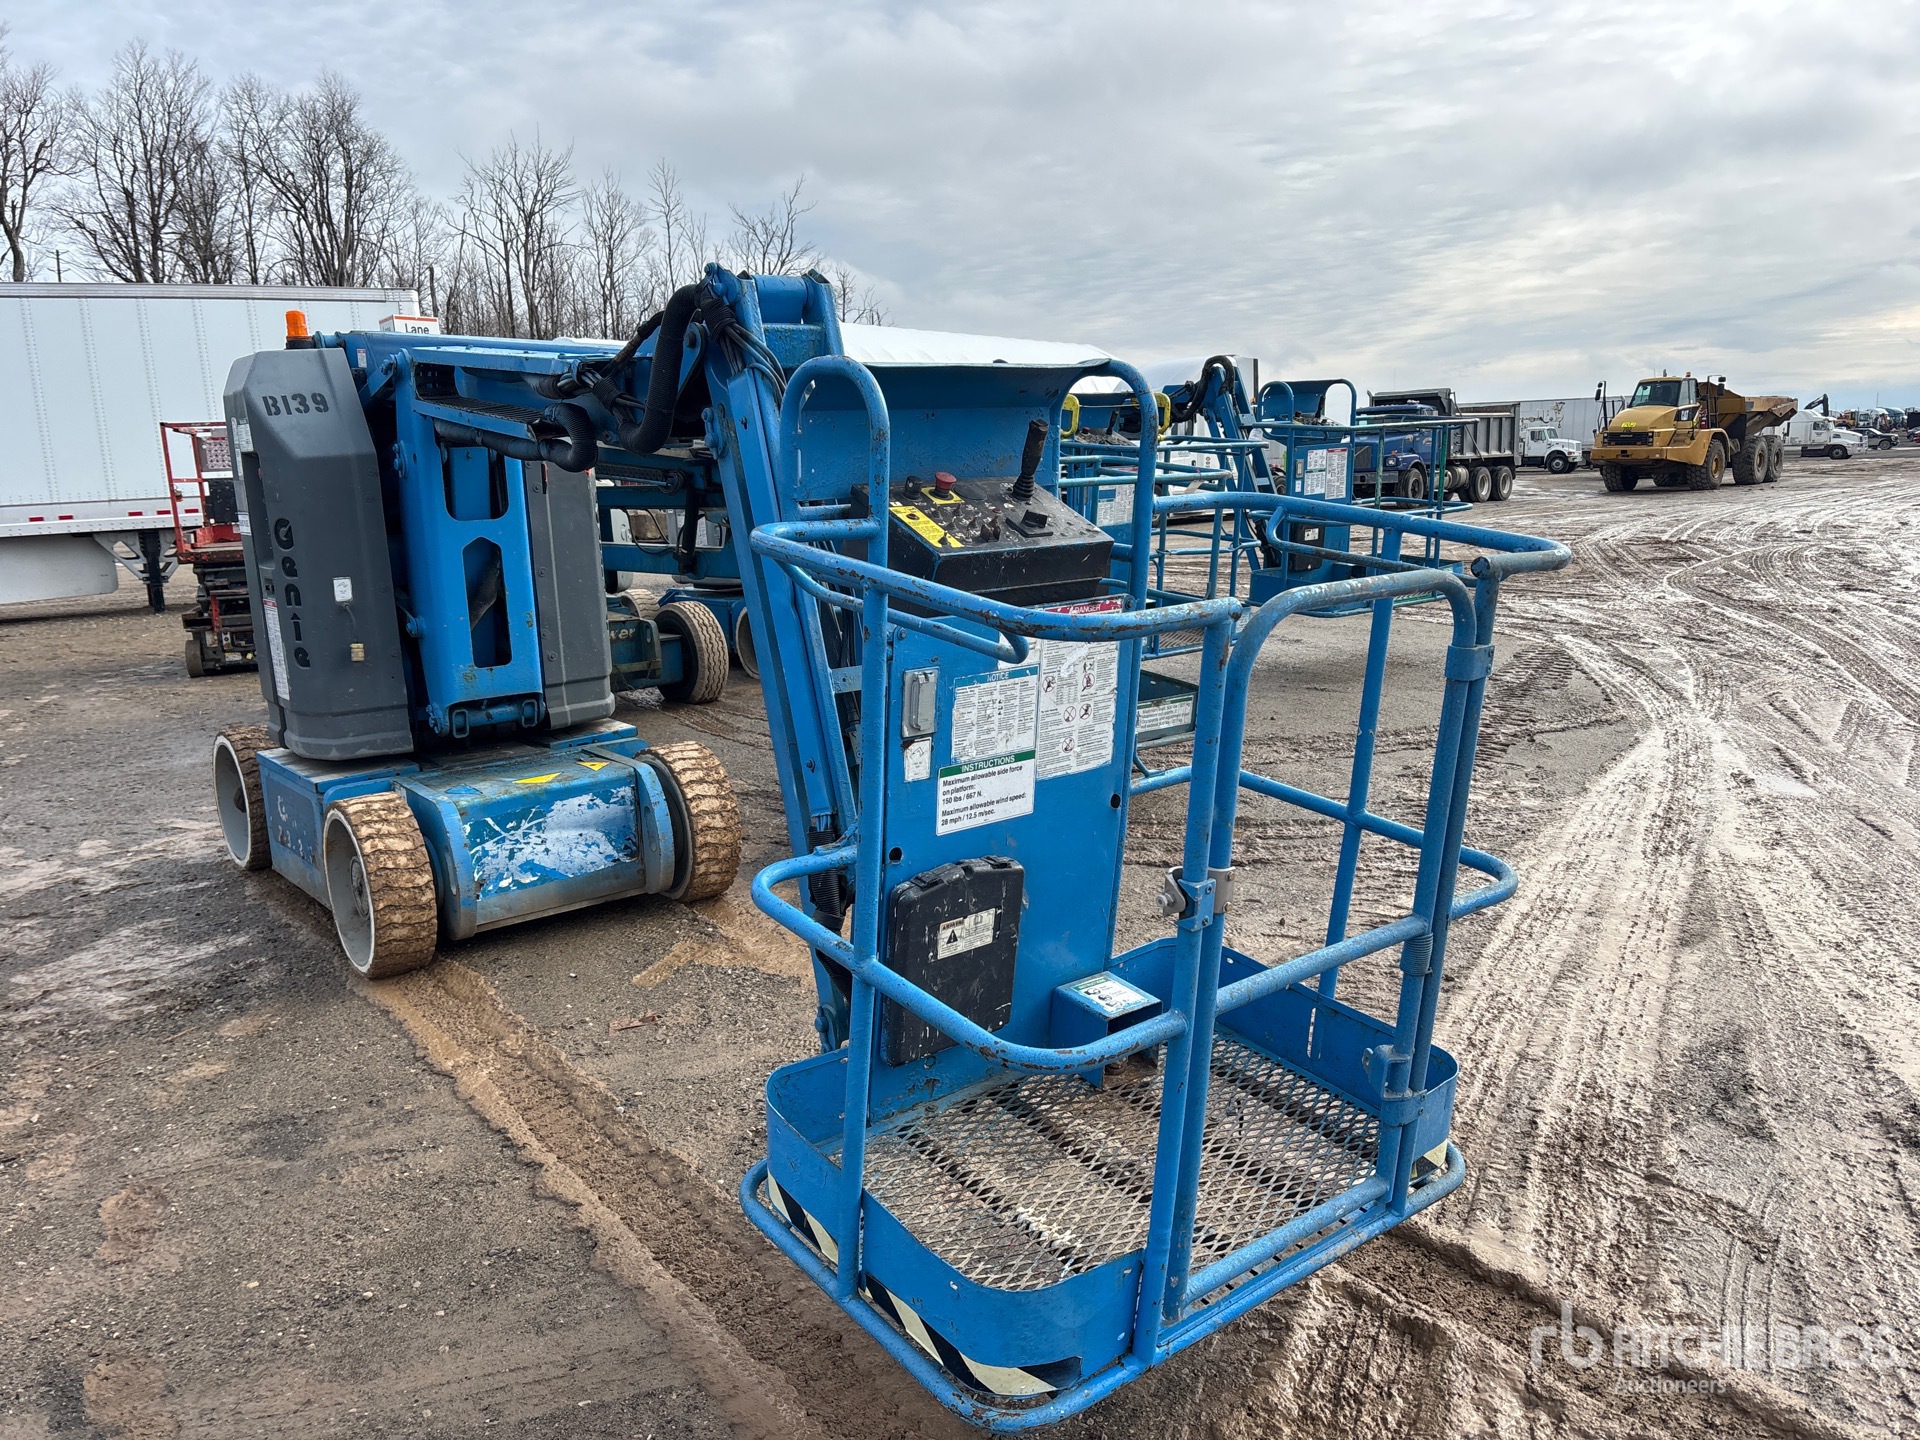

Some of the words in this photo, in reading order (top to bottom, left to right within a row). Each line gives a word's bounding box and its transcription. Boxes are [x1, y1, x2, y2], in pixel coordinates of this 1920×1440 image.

[404, 322, 430, 335] Lane
[274, 517, 311, 669] Genie
[1075, 603, 1101, 613] DANGER
[987, 671, 1009, 682] NOTICE
[961, 755, 1015, 773] INSTRUCTIONS
[943, 776, 970, 788] Maximum
[971, 770, 996, 781] allowable
[997, 767, 1008, 775] side
[1009, 765, 1022, 773] force
[951, 784, 976, 796] platform:
[941, 806, 968, 817] Maximum
[970, 800, 995, 811] allowable
[995, 796, 1008, 805] wind
[1009, 792, 1026, 802] speed:
[942, 797, 952, 805] 150
[953, 795, 962, 803] lbs
[941, 818, 948, 826] 28
[949, 815, 961, 824] mph
[966, 811, 977, 820] 12.5
[978, 809, 995, 817] m/sec.
